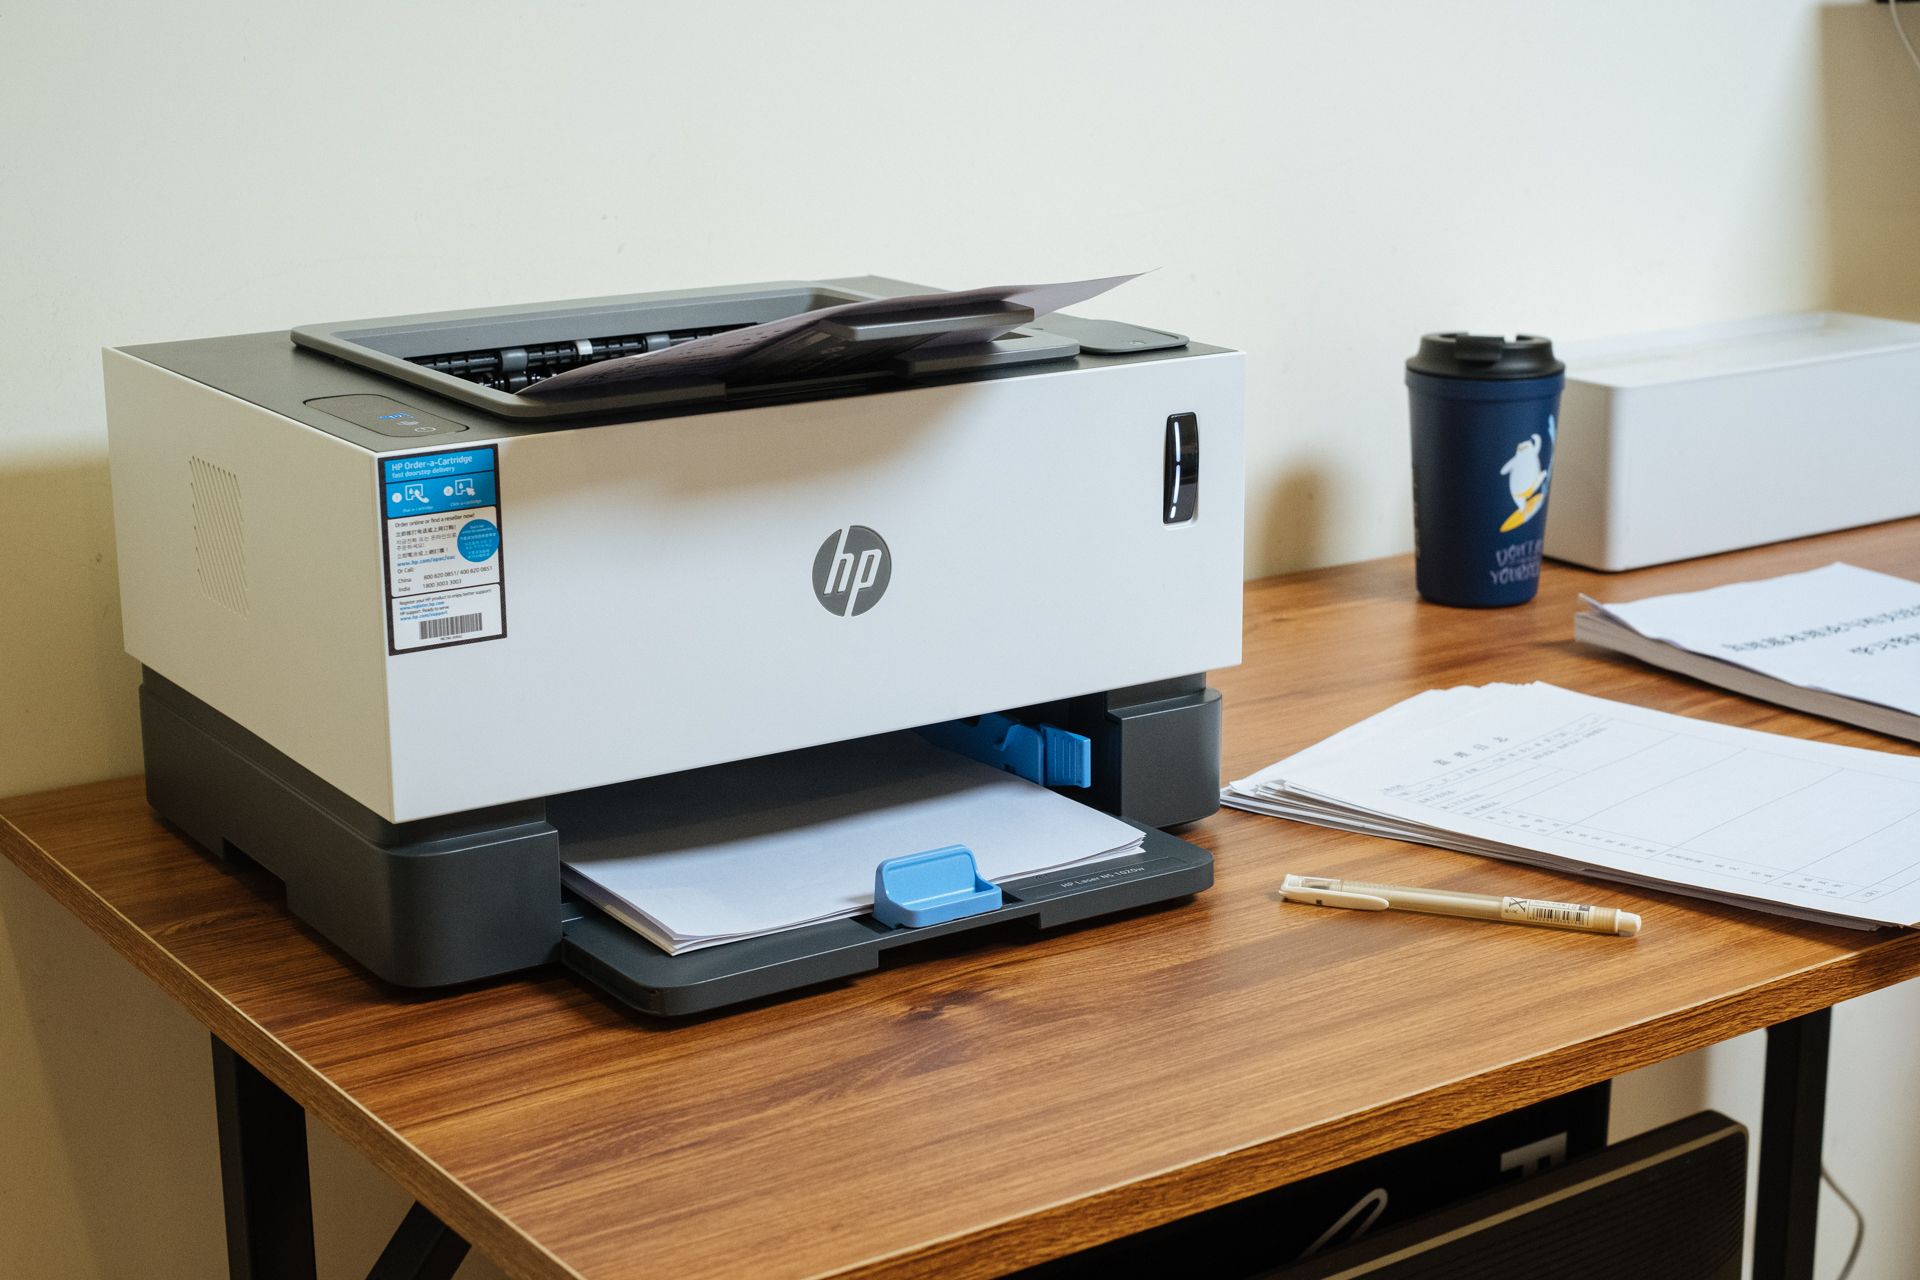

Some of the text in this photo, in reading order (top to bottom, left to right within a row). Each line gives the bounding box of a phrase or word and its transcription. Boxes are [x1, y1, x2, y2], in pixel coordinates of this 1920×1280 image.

[392, 455, 472, 471] HP Order-a-Cartridge
[405, 469, 431, 477] doorstep
[1074, 876, 1100, 885] Laser
